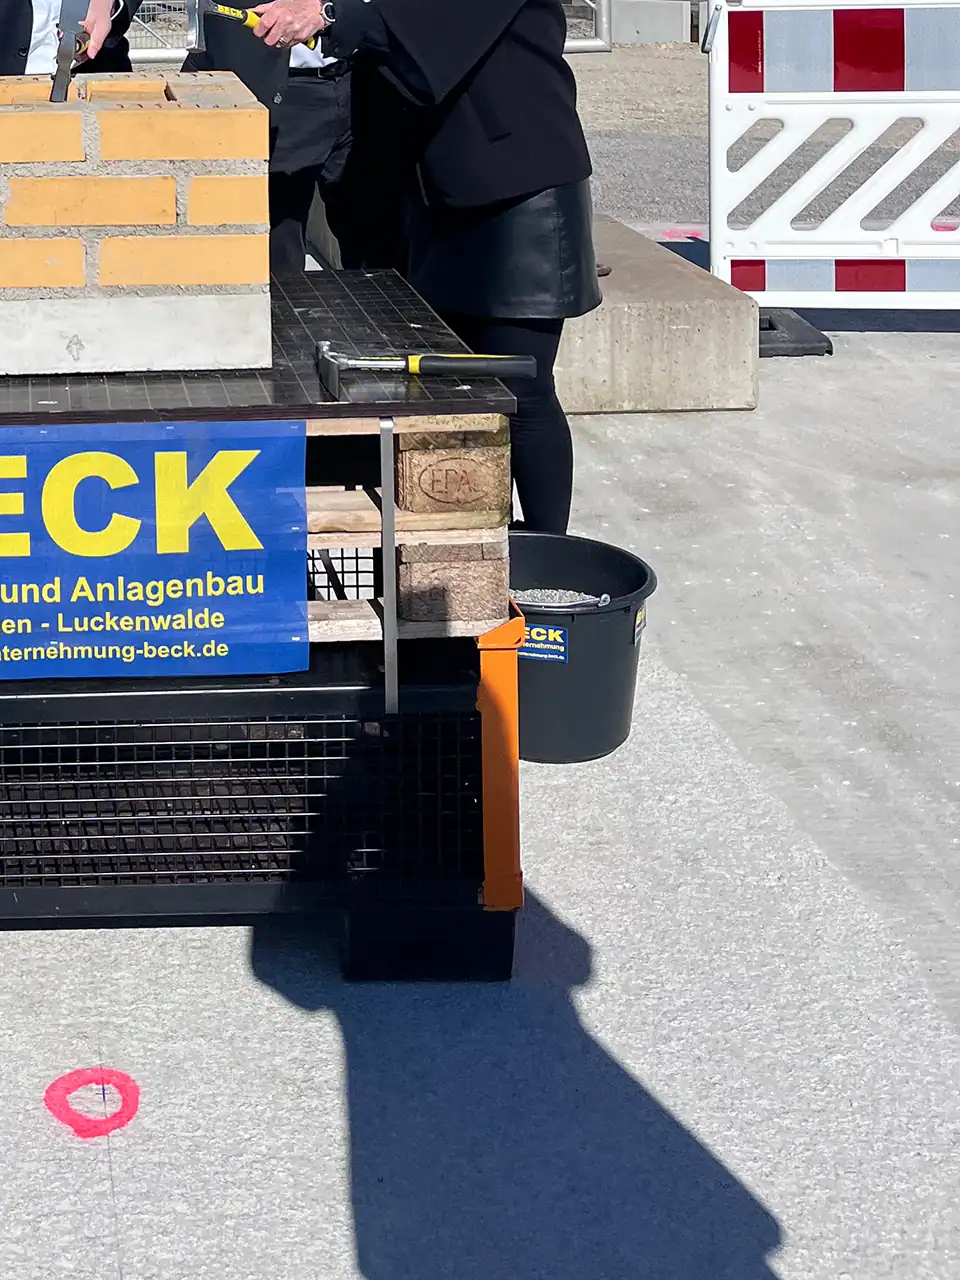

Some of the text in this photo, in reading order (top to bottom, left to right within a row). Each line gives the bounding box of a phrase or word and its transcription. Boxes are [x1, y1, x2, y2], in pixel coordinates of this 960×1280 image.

[218, 4, 243, 19] BECK
[0, 577, 61, 605] und
[70, 571, 265, 606] Anlagenbau
[56, 608, 225, 633] Luckenwalde
